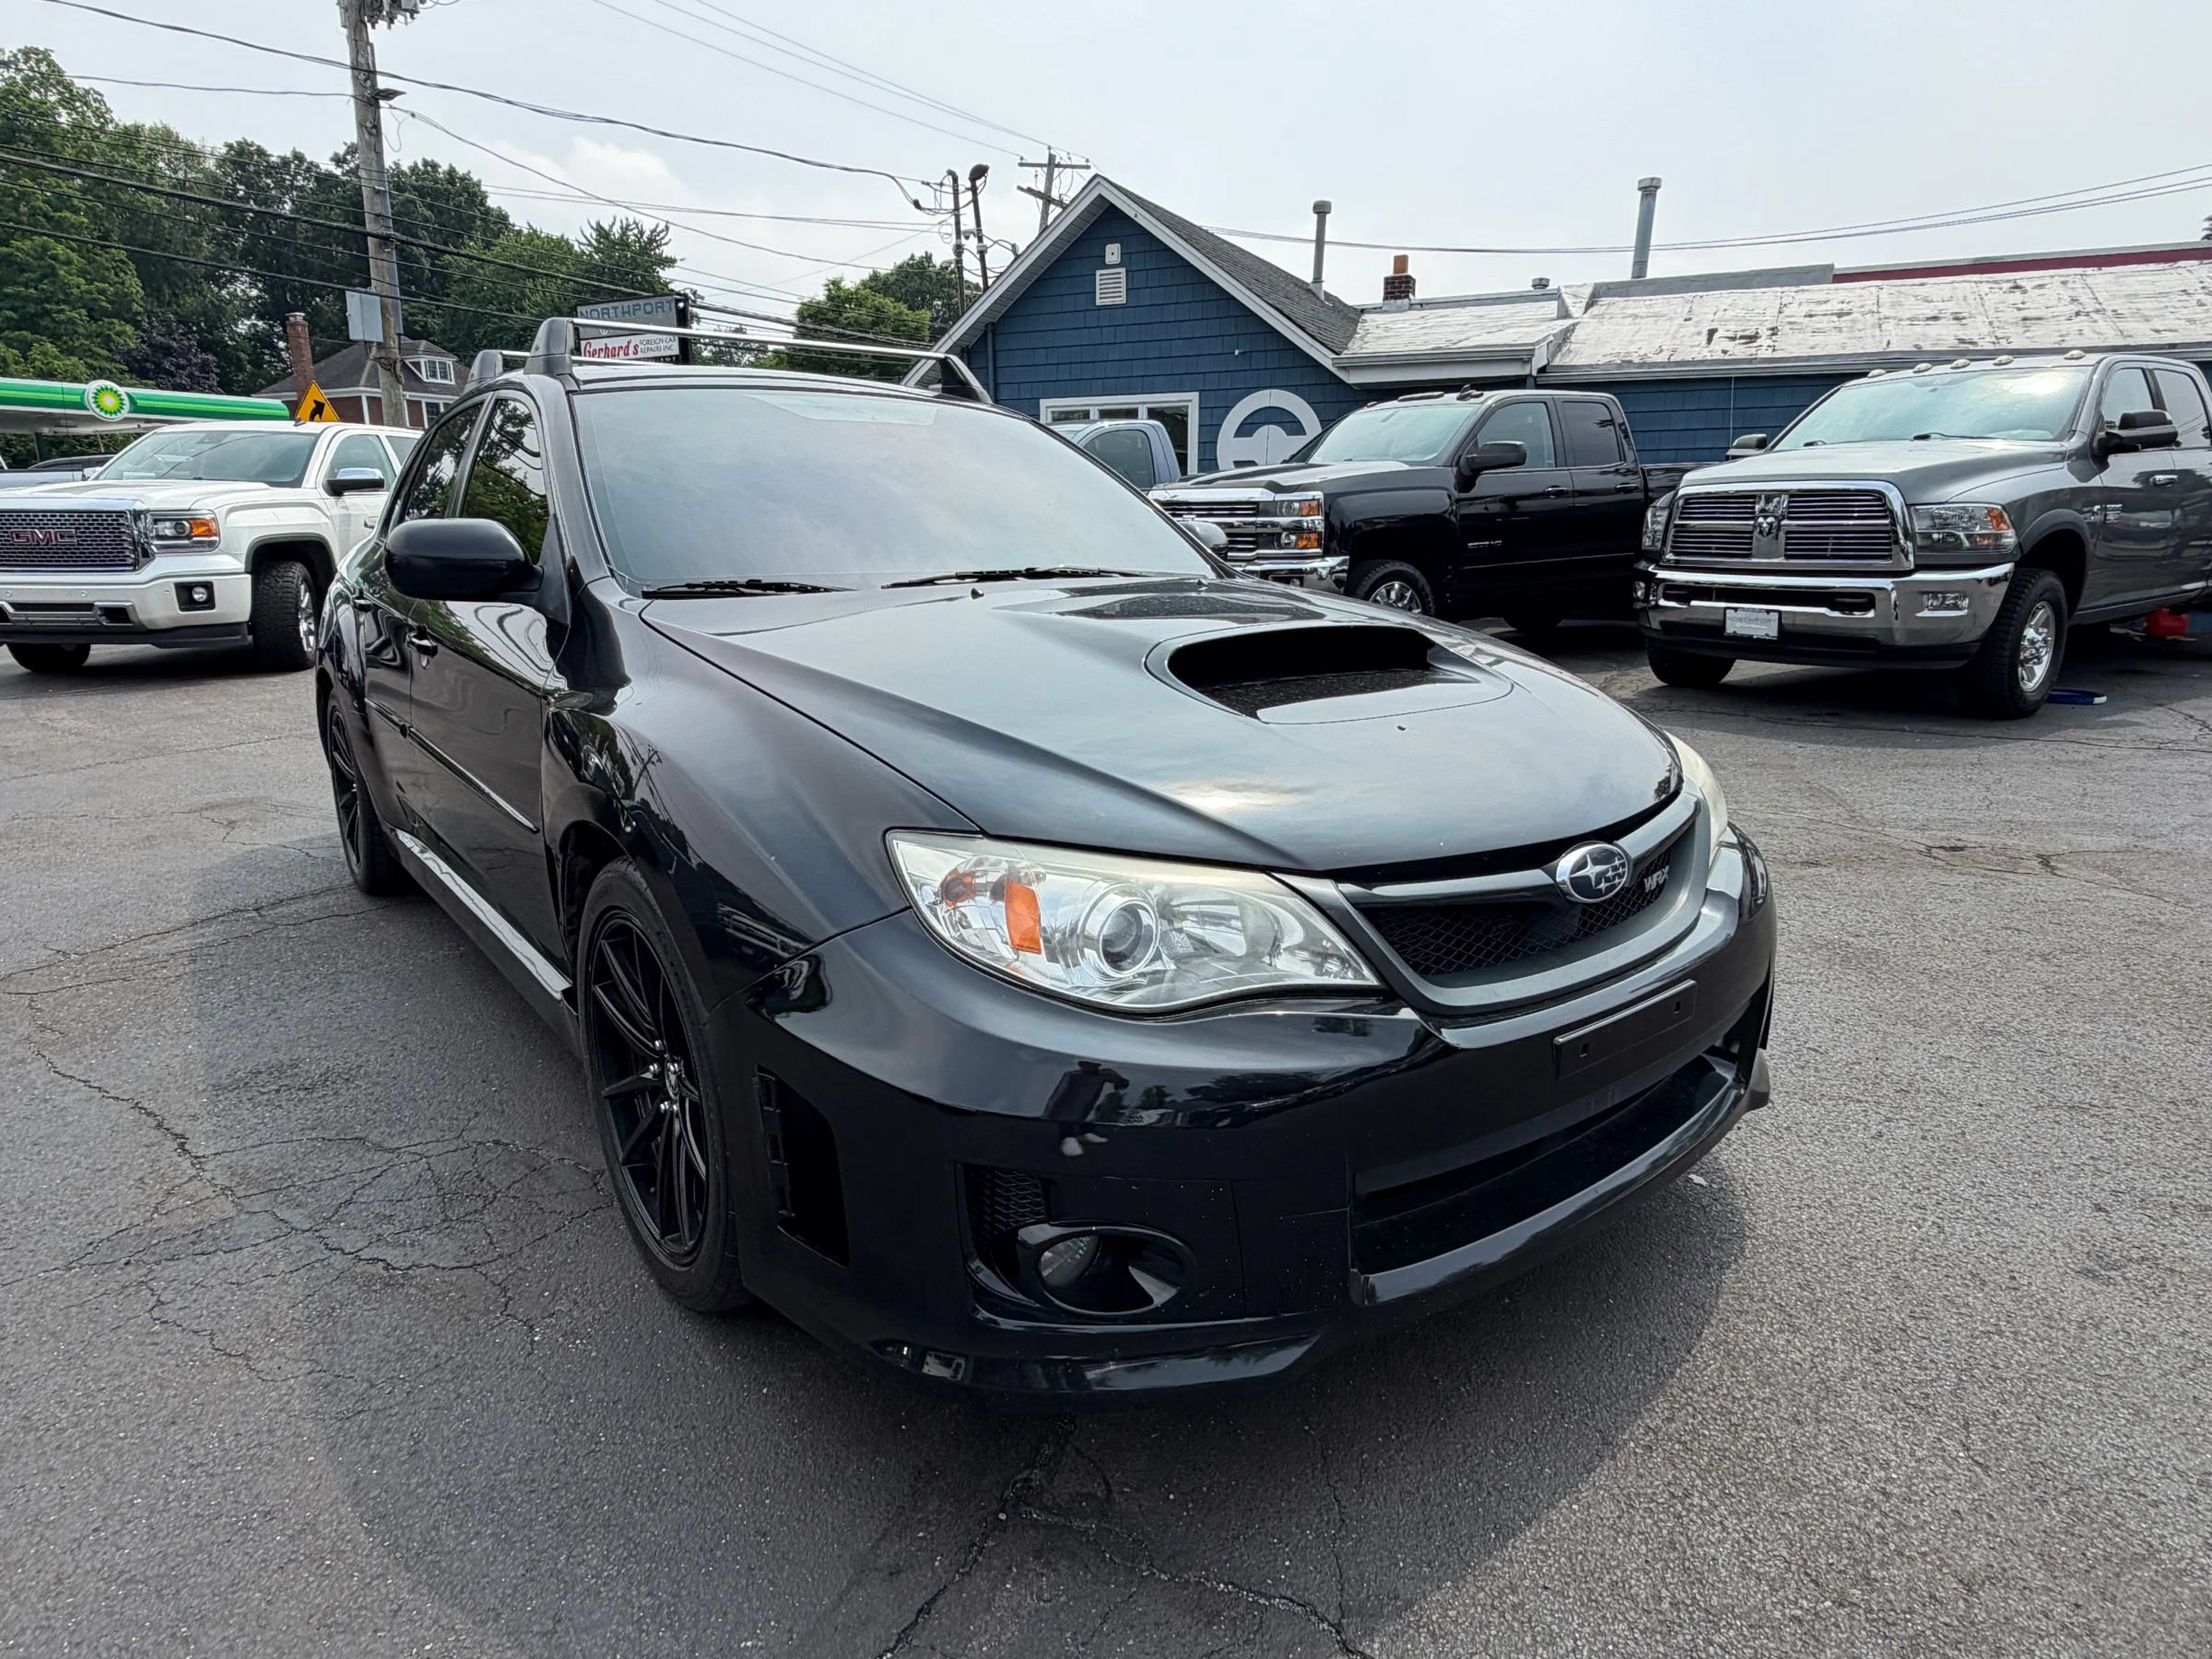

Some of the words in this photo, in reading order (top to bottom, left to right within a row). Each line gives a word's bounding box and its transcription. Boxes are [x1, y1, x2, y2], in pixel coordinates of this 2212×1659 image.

[580, 301, 673, 319] NORTHPORT
[584, 340, 639, 359] Gerhard's
[639, 337, 664, 346] FOREIGN
[640, 346, 662, 354] REPAIRS
[10, 529, 77, 545] GMC
[1643, 865, 1670, 893] WRX
